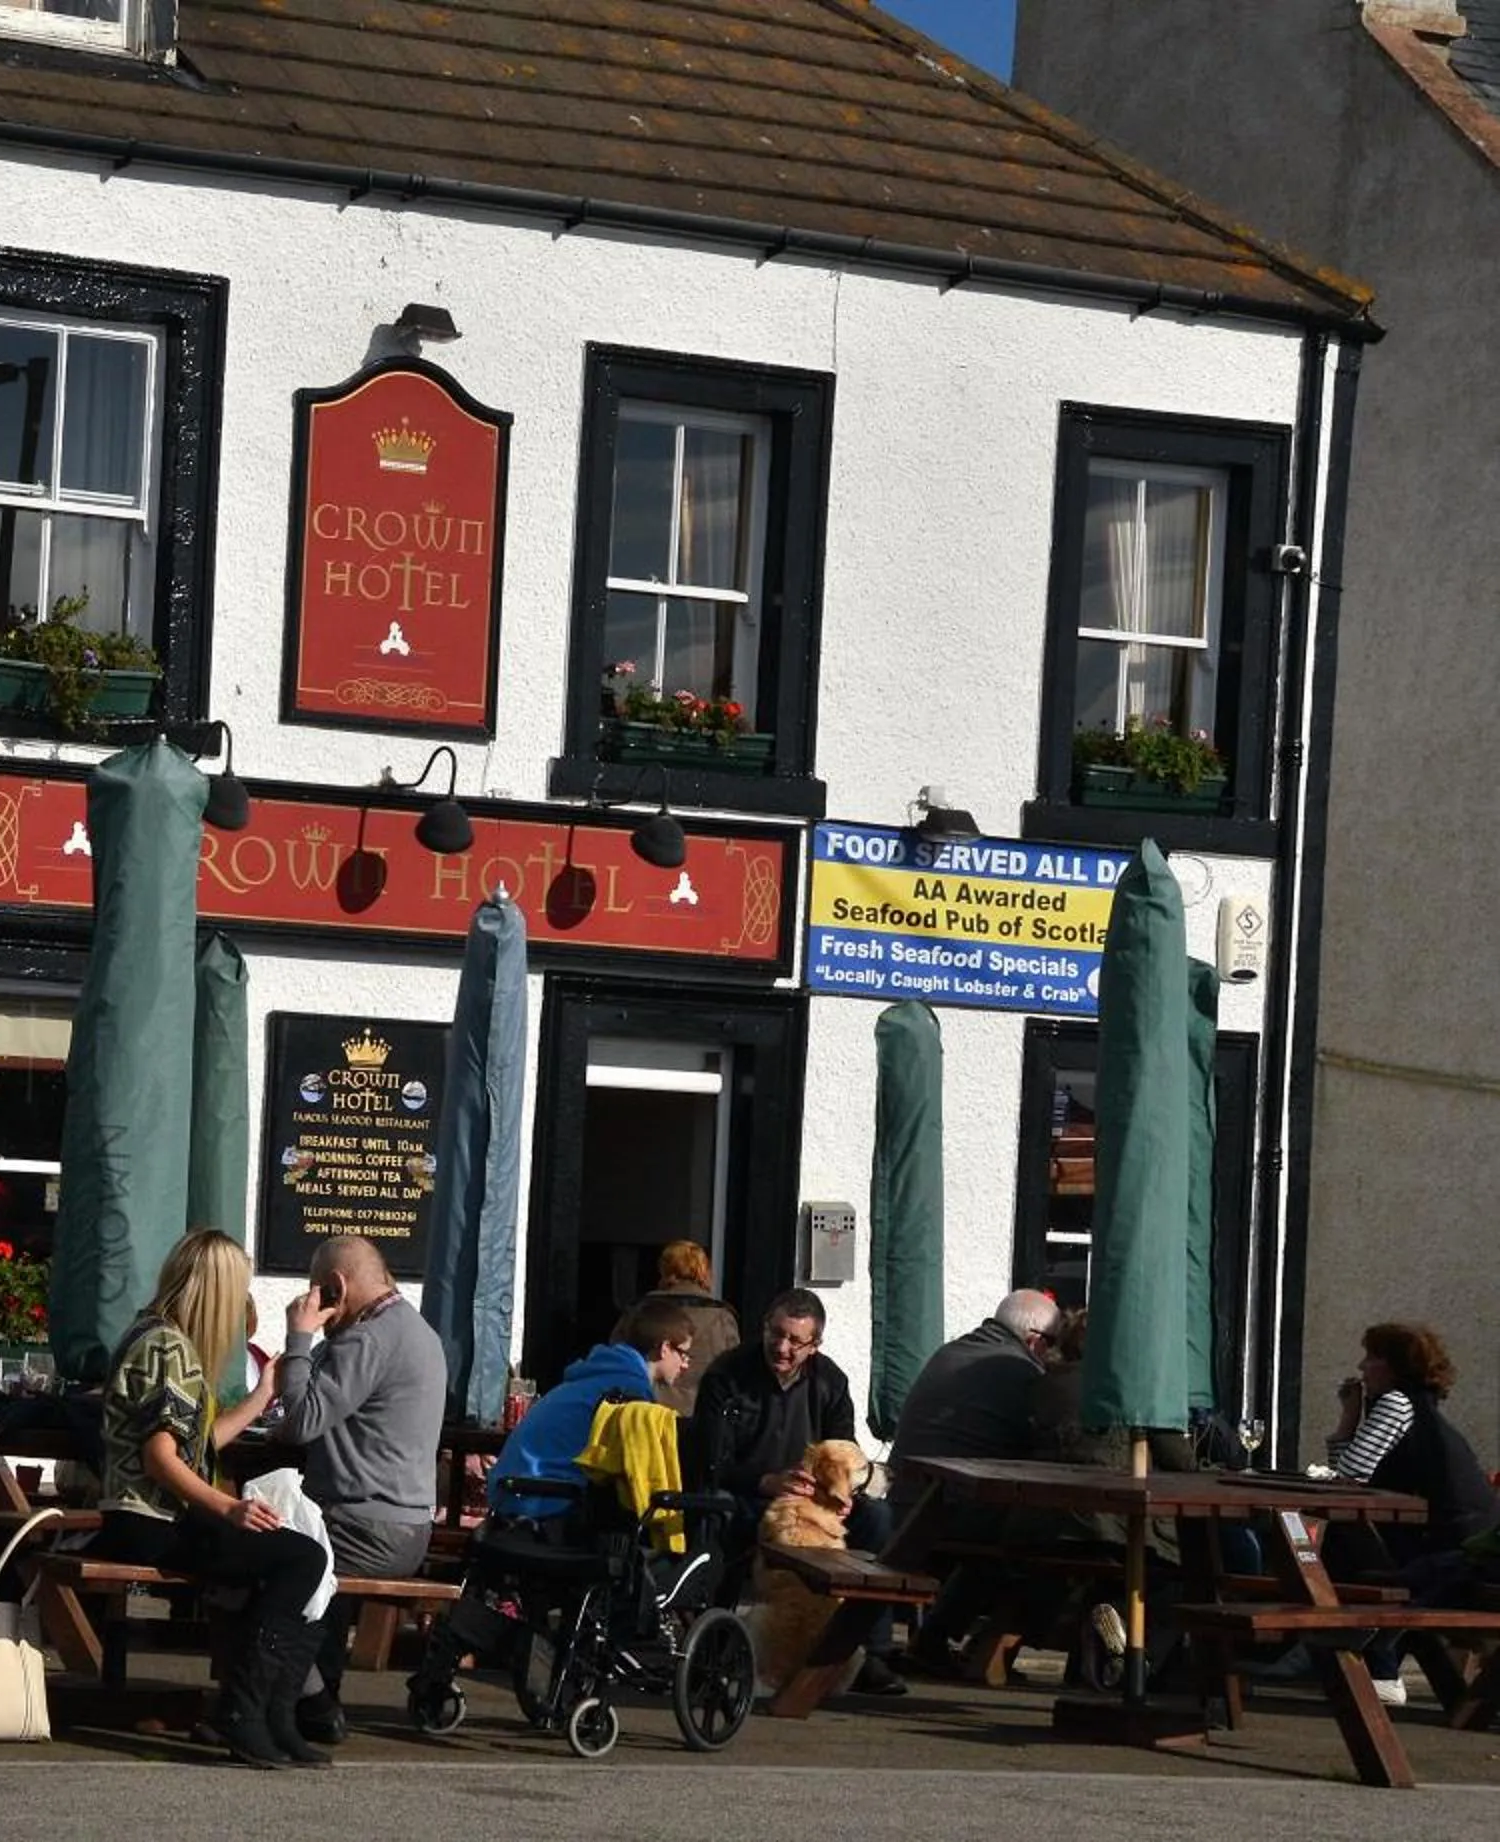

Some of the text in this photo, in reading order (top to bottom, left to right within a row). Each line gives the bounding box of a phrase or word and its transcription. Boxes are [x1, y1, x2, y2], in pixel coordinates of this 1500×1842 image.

[312, 503, 485, 555] CROWN
[323, 551, 470, 611] HOTEL
[827, 832, 905, 863] FOOD
[915, 843, 1026, 875] SERVED
[1036, 854, 1088, 881] ALL
[197, 833, 634, 913] ROWN HOTEL
[913, 879, 1066, 912] AA Awarded
[833, 898, 1107, 944] Seafood Pub of Scotla
[821, 936, 1078, 979] Fresh Seafood Specials
[891, 971, 949, 994] Caught
[955, 978, 1018, 999] Lobster
[1024, 984, 1035, 999] &
[328, 1070, 400, 1089] CROWN
[333, 1088, 393, 1112] HOTEL
[299, 1134, 358, 1148] BREAKFAST
[362, 1138, 391, 1151] UNTIL
[315, 1151, 403, 1167] MORNING COFFEE
[317, 1168, 401, 1183] AFTERNOON TEA
[295, 1183, 423, 1199] MEALS SERVED ALL DAY
[304, 1223, 328, 1234] OPEN
[331, 1224, 342, 1235] TO
